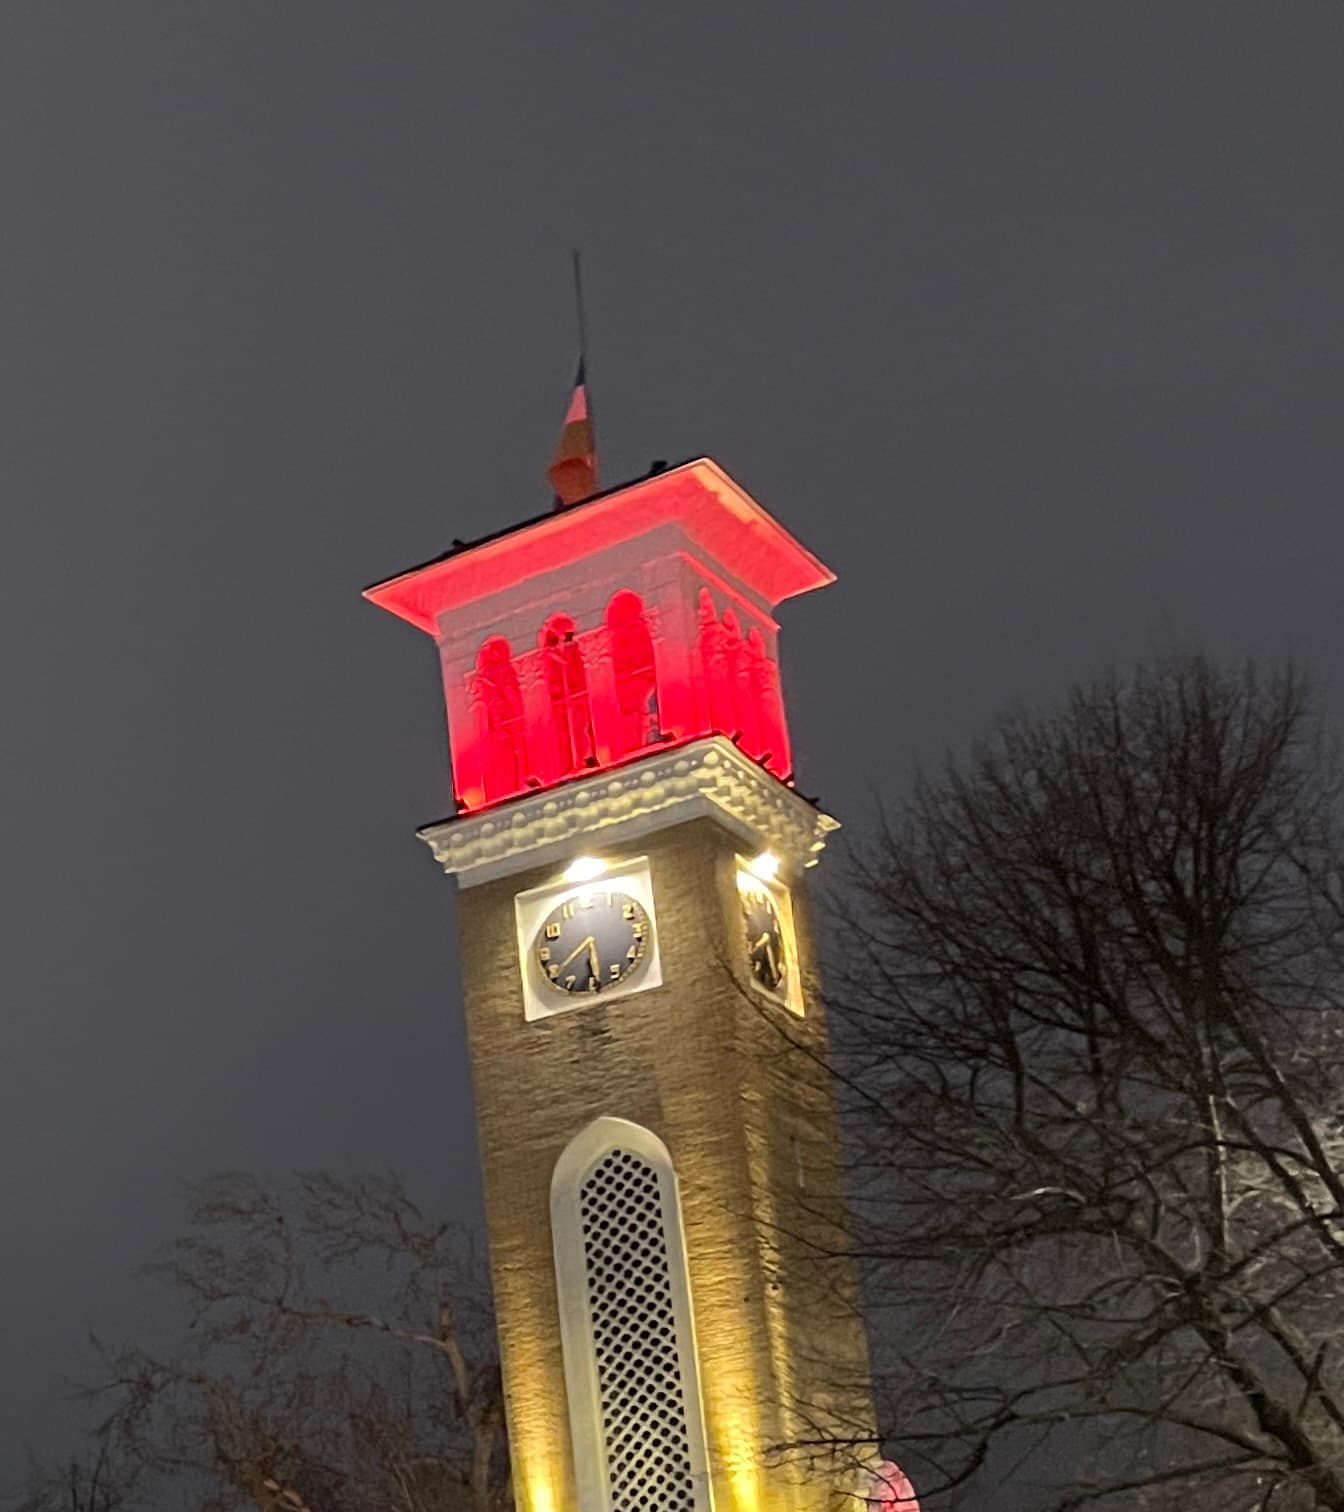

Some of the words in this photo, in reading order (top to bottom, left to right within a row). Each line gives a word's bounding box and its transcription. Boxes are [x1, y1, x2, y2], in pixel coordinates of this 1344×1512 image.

[622, 903, 634, 920] 2
[546, 922, 561, 938] 10
[626, 944, 636, 959] 4
[610, 963, 620, 980] 5
[566, 975, 576, 990] 7
